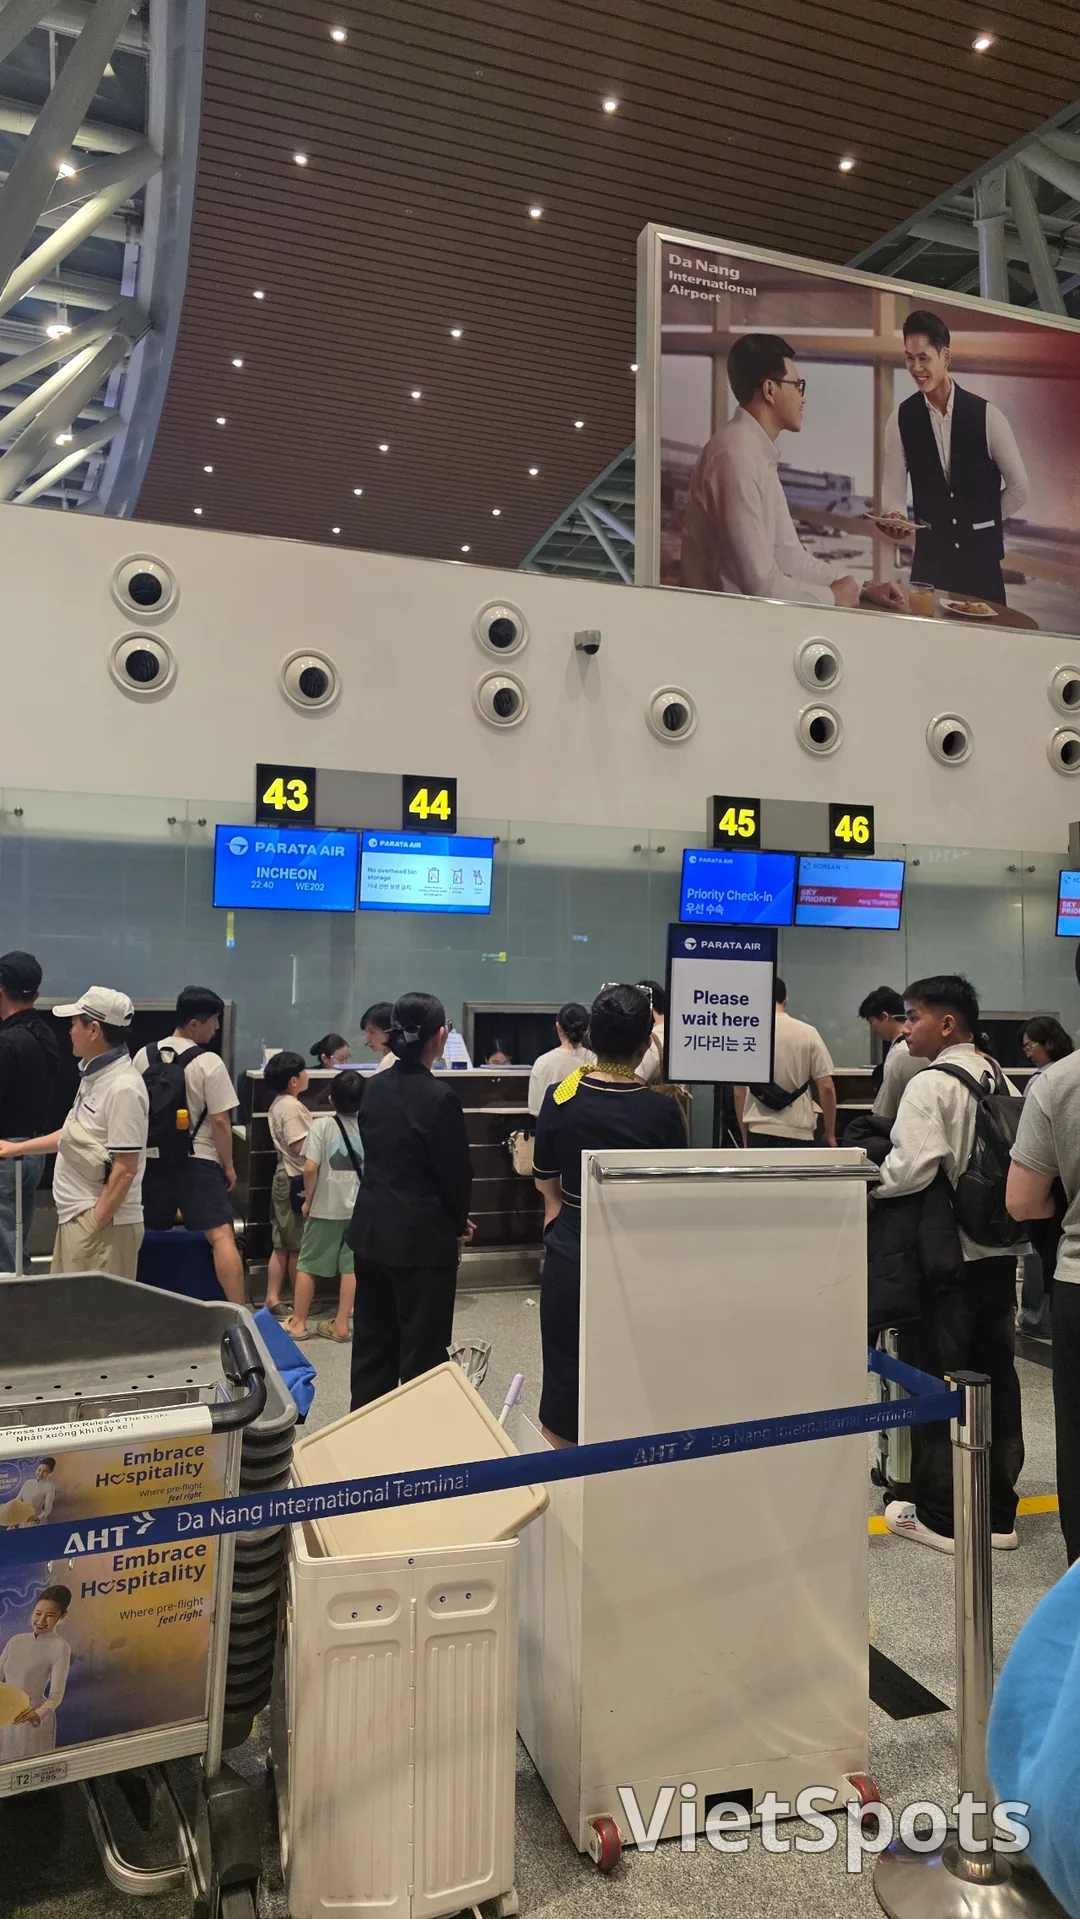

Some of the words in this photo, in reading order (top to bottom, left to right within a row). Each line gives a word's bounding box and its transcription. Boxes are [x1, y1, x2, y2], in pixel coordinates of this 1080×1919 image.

[669, 253, 692, 268] Da
[696, 259, 740, 280] Nang
[669, 270, 757, 296] International
[669, 284, 721, 302] Airport
[262, 777, 309, 812] 43
[408, 788, 451, 820] 44
[718, 807, 756, 838] 45
[834, 815, 870, 844] 46
[255, 841, 317, 855] PARATA
[320, 845, 345, 857] AIR
[379, 840, 408, 848] PARATA
[256, 866, 318, 880] INCHEON
[295, 882, 325, 891] WE202
[801, 888, 818, 896] SKY
[687, 888, 724, 903] Priority
[726, 889, 773, 902] Check-in
[800, 895, 837, 904] PRIORITY
[685, 902, 704, 915] 우선
[705, 903, 725, 916] 수속
[700, 940, 742, 950] PARATA
[743, 942, 761, 950] AIR
[693, 989, 749, 1006] Please
[682, 1010, 718, 1026] wait
[721, 1012, 760, 1027] here
[684, 1035, 739, 1052] 기다리는
[743, 1036, 757, 1052] 곳
[3, 1429, 35, 1437] Press
[37, 1425, 66, 1433] Down
[82, 1417, 121, 1427] Release
[79, 1427, 95, 1435] khi
[632, 1442, 679, 1465] AHT
[711, 1431, 731, 1449] Da
[734, 1426, 772, 1445] Nang
[775, 1412, 860, 1439] International
[123, 1445, 205, 1467] Embrace
[139, 1487, 165, 1497] Where
[166, 1482, 203, 1495] pre-flight
[167, 1494, 182, 1504] feel
[183, 1491, 202, 1501] right
[63, 1525, 130, 1555] AHT
[177, 1511, 204, 1532] Da
[210, 1504, 263, 1527] Nang
[269, 1480, 390, 1517] International
[393, 1469, 470, 1499] Terminal
[113, 1543, 207, 1573] Embrace
[119, 1608, 154, 1621] Where
[156, 1597, 204, 1616] pre-flight
[157, 1615, 177, 1628] feel
[179, 1608, 203, 1623] right
[16, 1774, 30, 1786] T2
